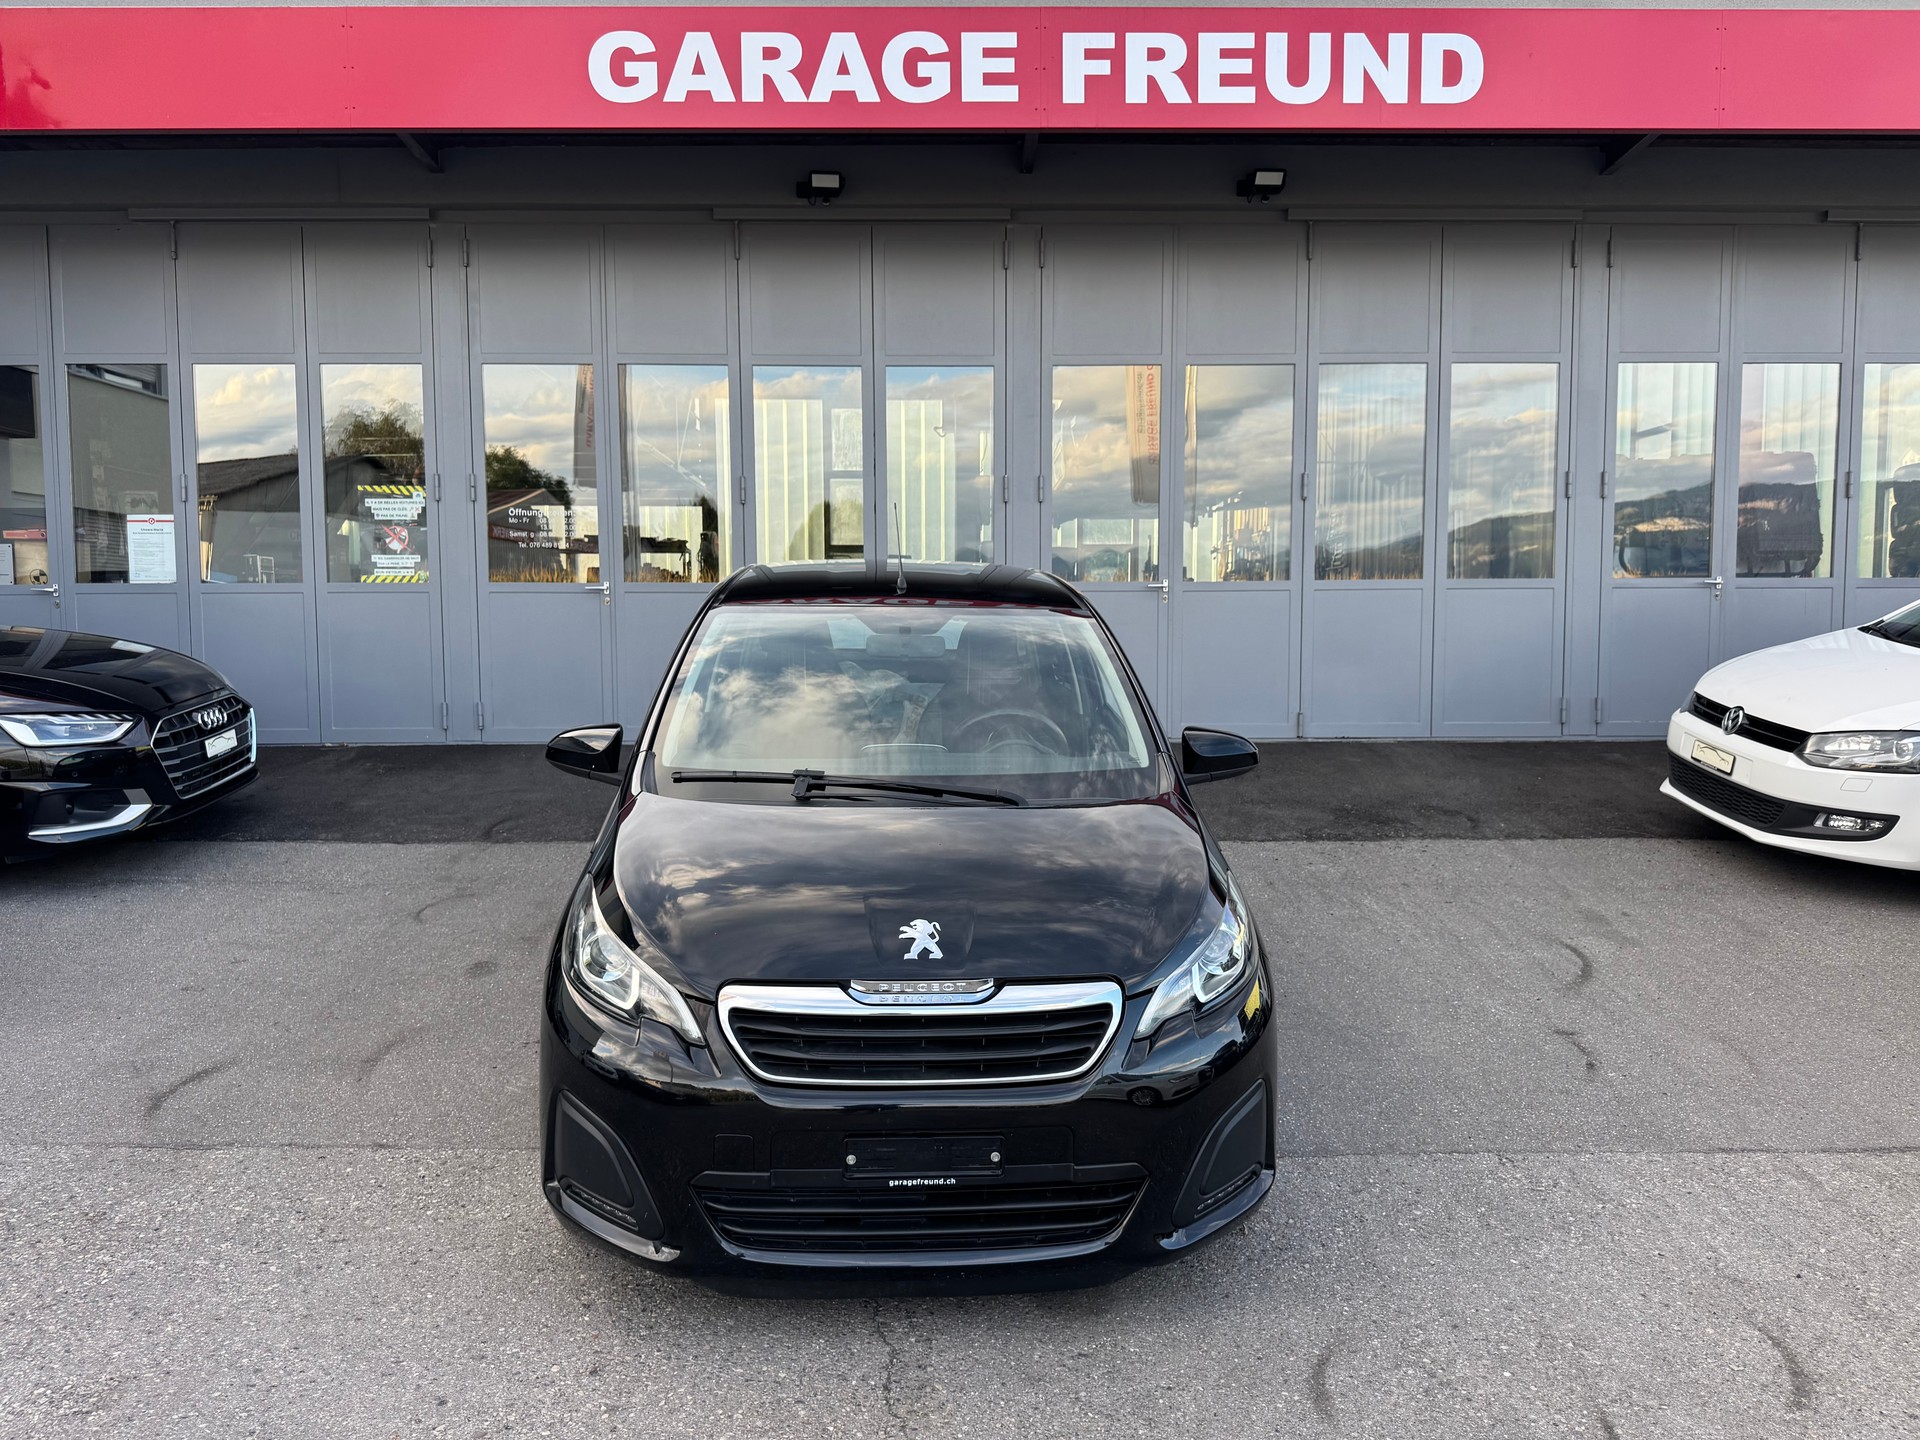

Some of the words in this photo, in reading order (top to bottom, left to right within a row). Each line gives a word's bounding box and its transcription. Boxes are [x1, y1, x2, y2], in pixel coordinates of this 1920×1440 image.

[588, 31, 1018, 104] GARAGE
[1063, 32, 1484, 104] FREUND
[879, 983, 966, 992] PEUGEOT
[889, 1178, 956, 1187] garagefreund.ch
